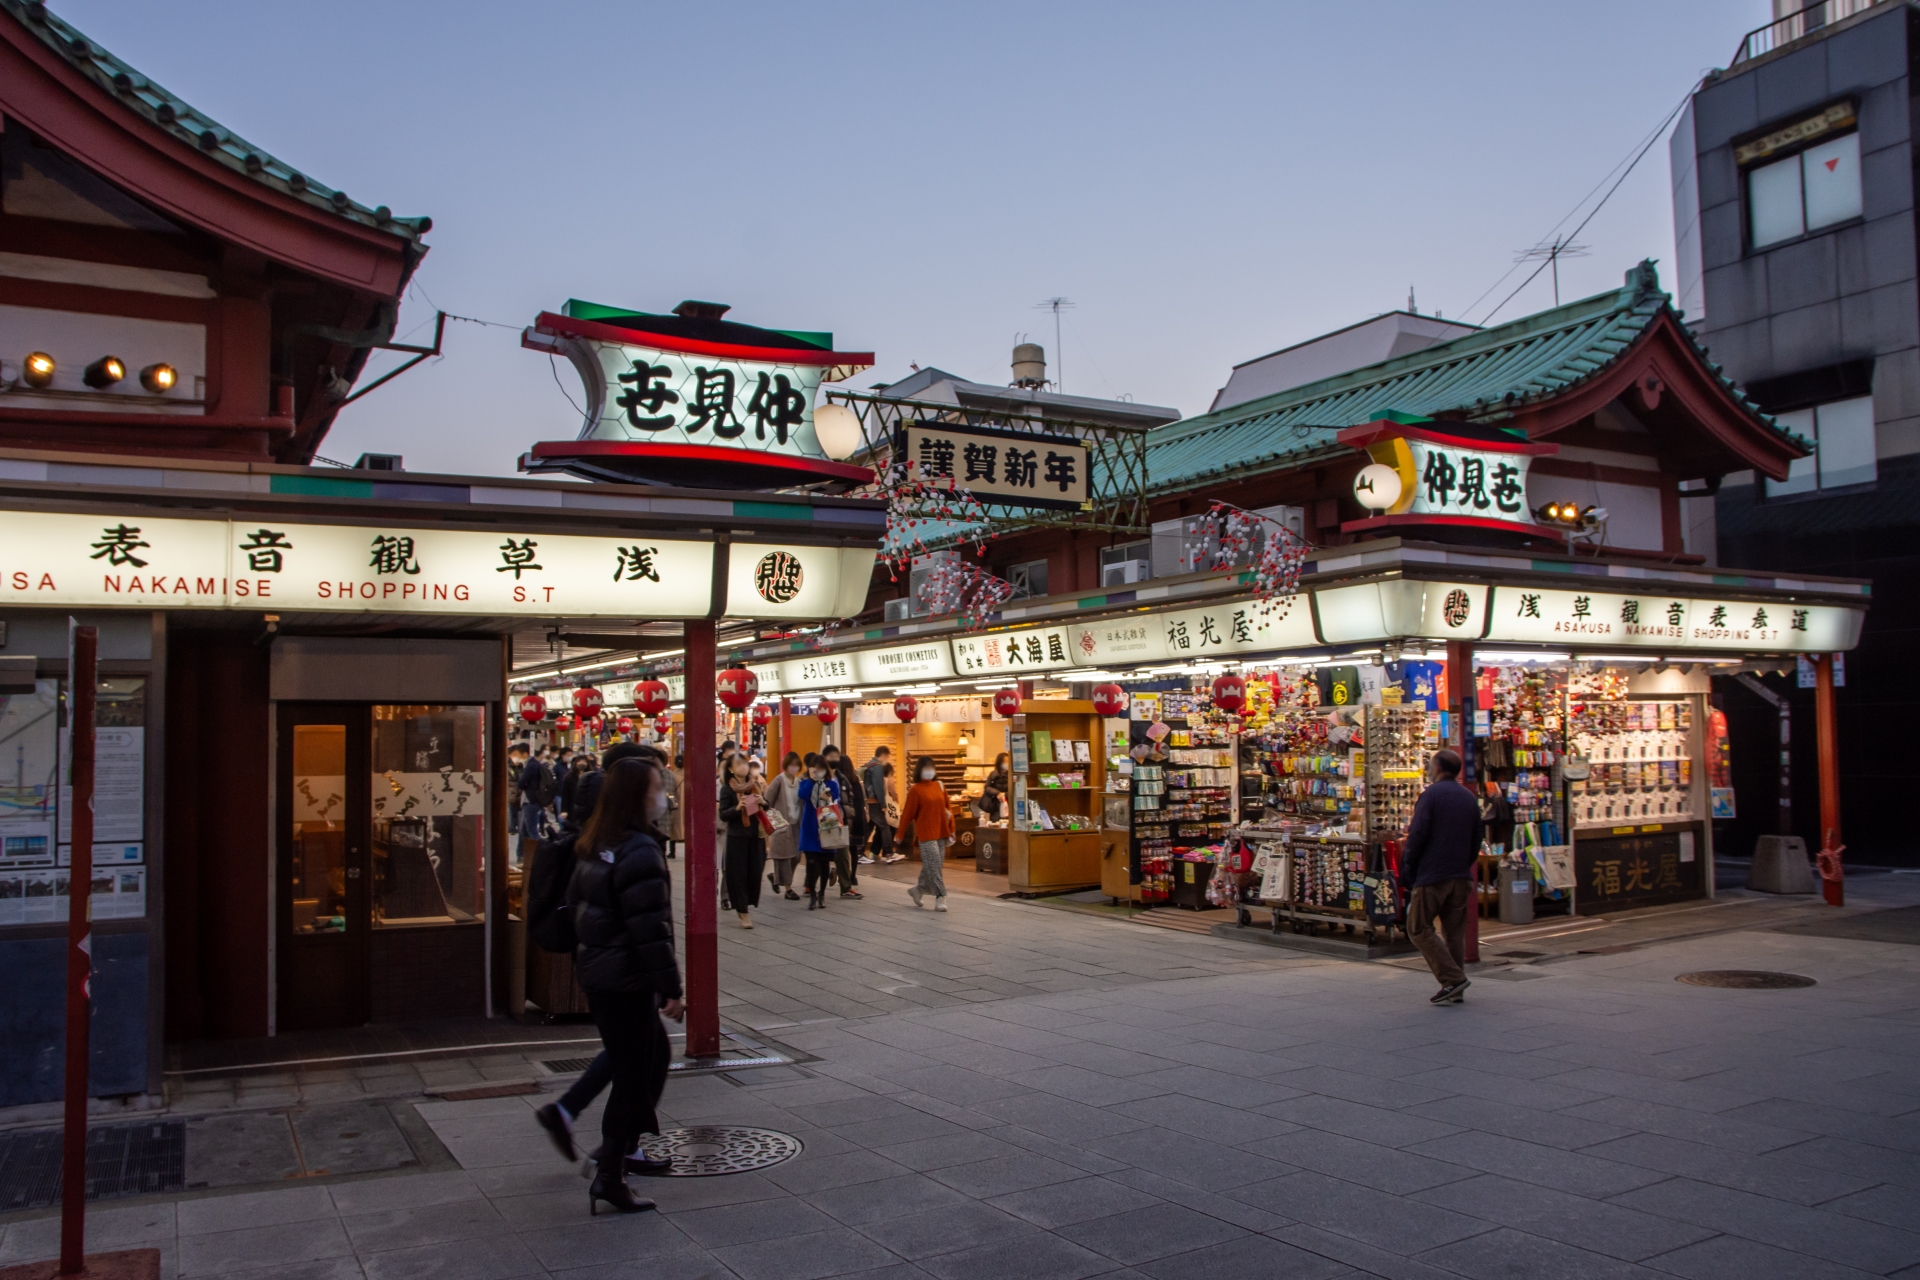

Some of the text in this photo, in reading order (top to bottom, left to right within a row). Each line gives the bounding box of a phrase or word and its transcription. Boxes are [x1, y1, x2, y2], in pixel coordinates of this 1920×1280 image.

[919, 437, 1077, 492] 謹賀新年
[0, 572, 555, 603] SA NAKAMISE SHOPPING S.T
[1517, 593, 1808, 632] 浅草観音表参道
[1167, 609, 1254, 650] 福光屋
[1554, 621, 1611, 634] ASAKUSA
[1625, 624, 1683, 638] NAKAMISE
[1694, 628, 1750, 640] SHOPPING
[877, 648, 938, 666] YOROSHI COSMETICS
[1006, 633, 1066, 665] 大海屋
[802, 660, 847, 680] よろし化粧堂
[1592, 852, 1683, 897] 福光屋
